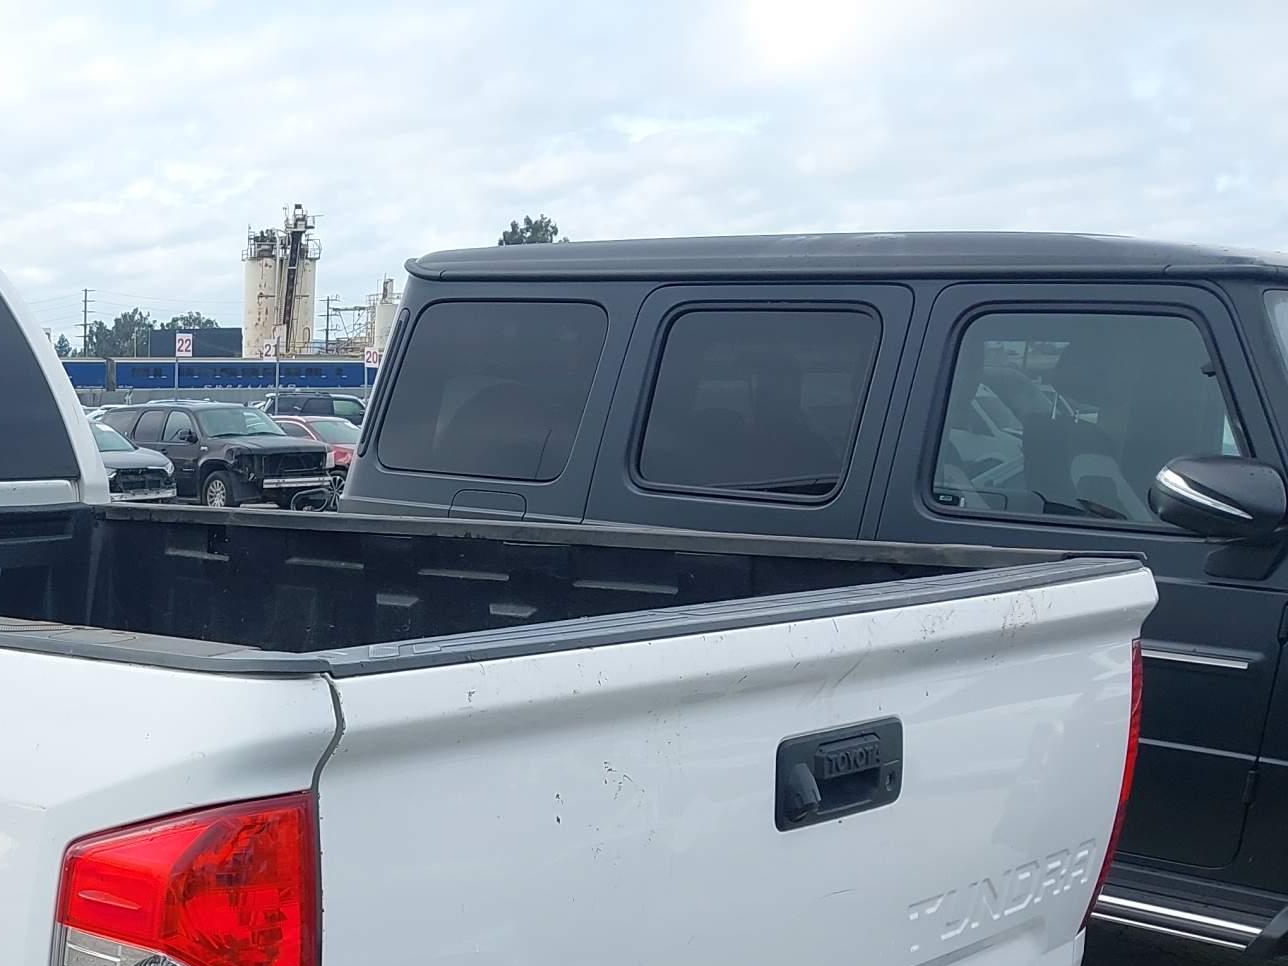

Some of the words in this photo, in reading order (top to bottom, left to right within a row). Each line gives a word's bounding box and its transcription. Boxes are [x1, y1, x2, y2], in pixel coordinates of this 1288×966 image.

[177, 338, 192, 353] 22
[365, 351, 379, 365] 20
[827, 744, 881, 774] TOYOTA
[907, 838, 1097, 952] TUNDRA
